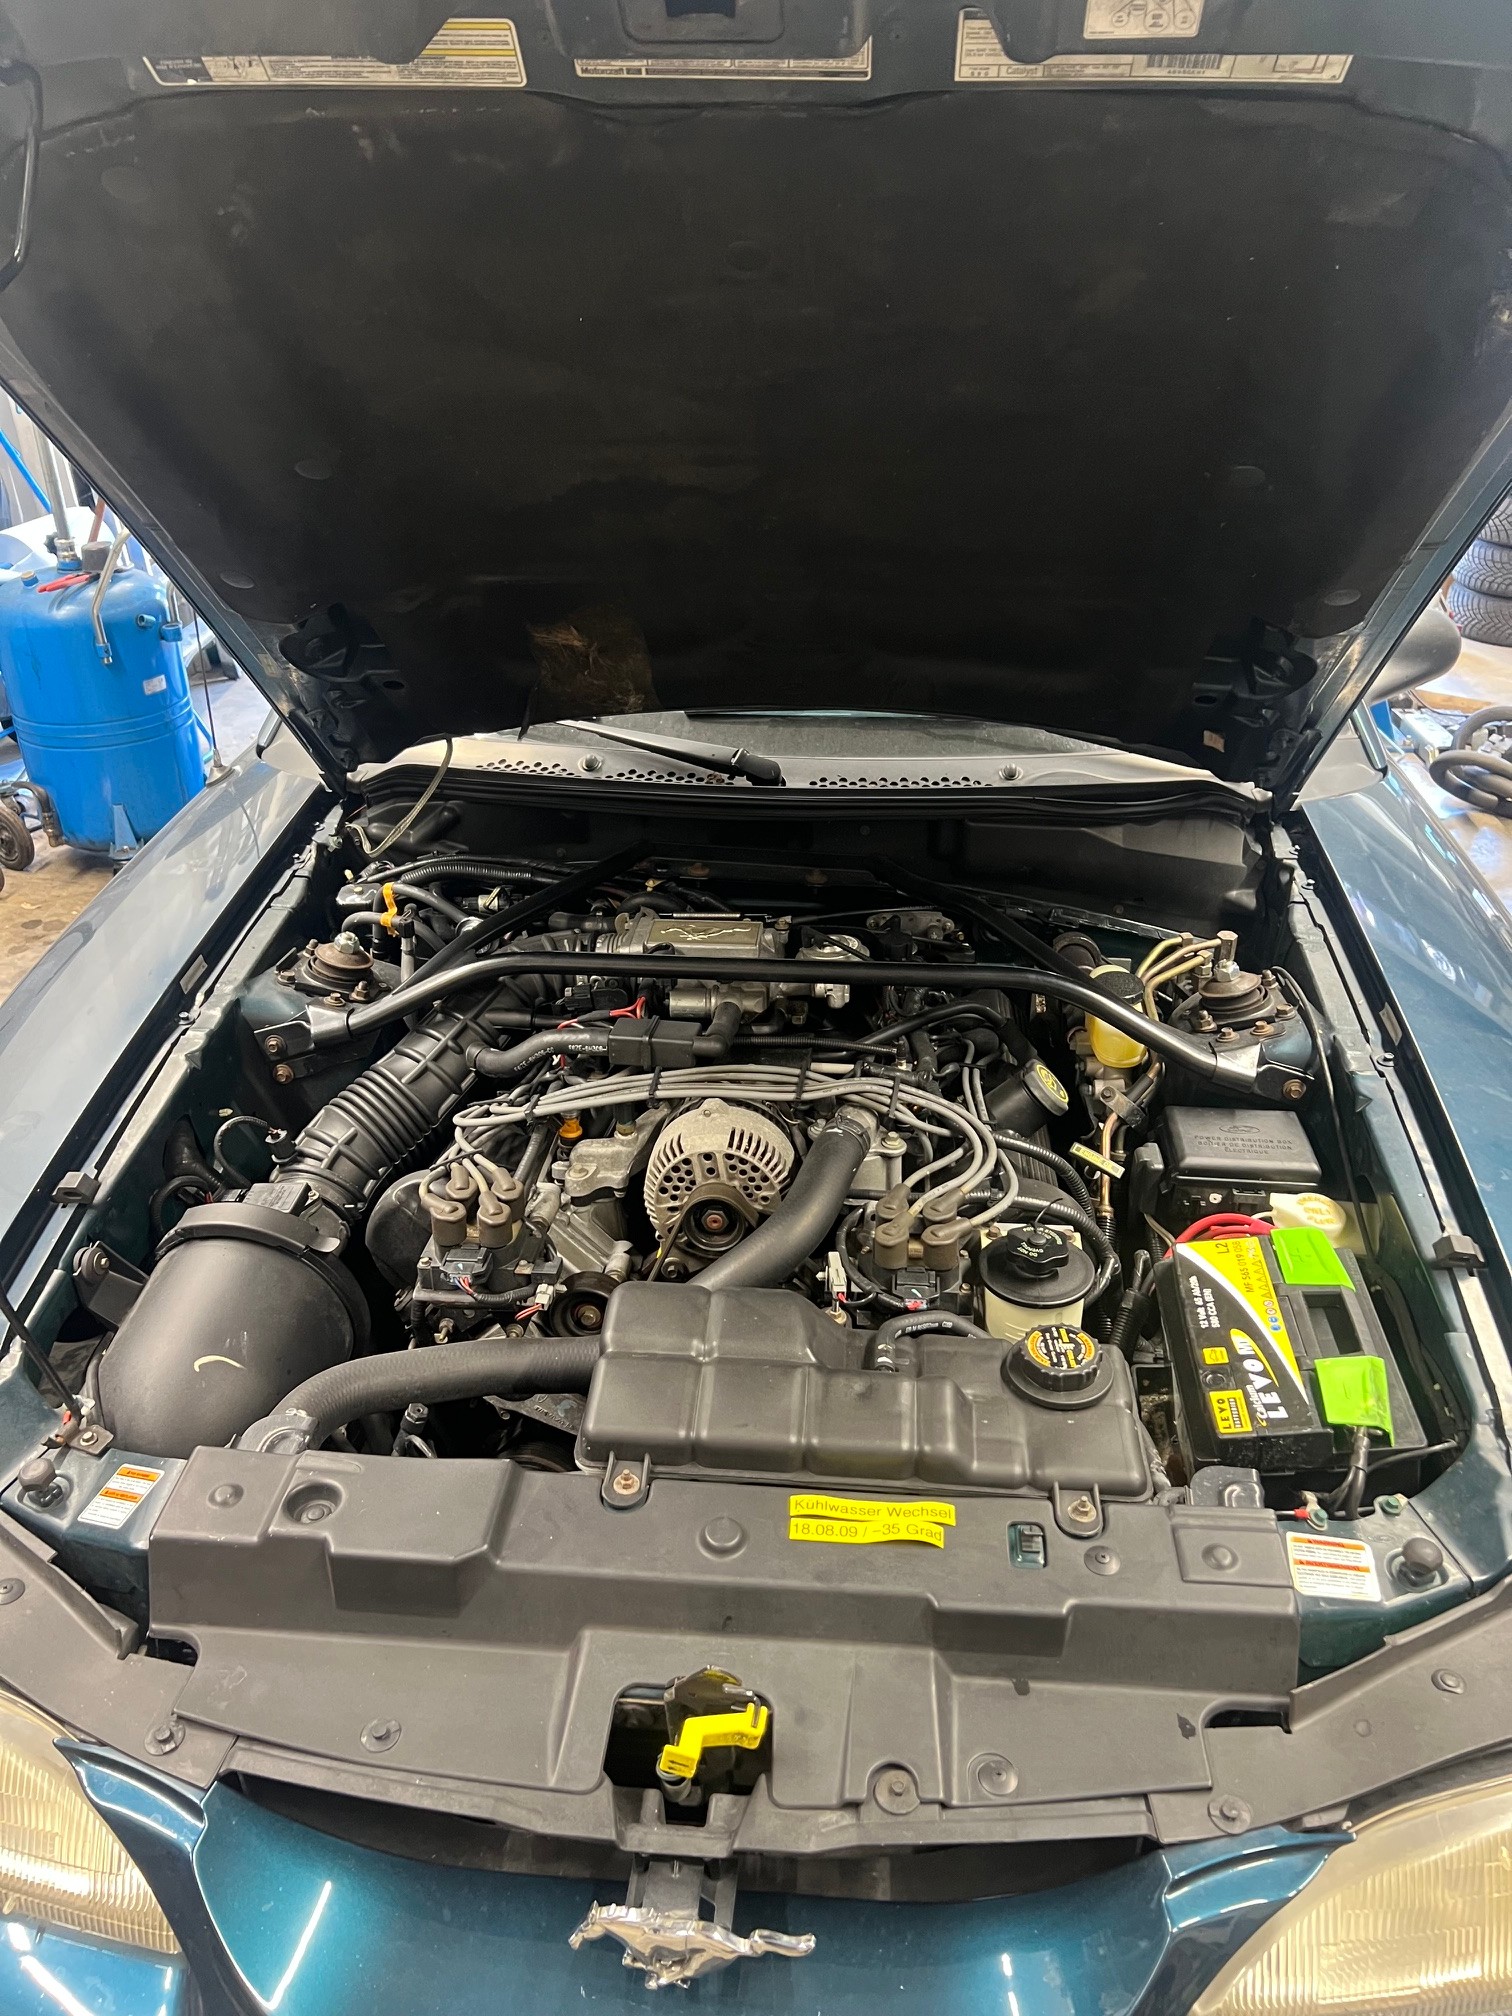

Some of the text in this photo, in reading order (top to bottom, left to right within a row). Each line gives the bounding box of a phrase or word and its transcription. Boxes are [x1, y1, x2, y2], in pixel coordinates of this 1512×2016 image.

[581, 66, 624, 75] Motorcraft
[1006, 66, 1038, 76] Catalyst
[1215, 1242, 1230, 1254] L2
[1236, 1254, 1247, 1266] 019
[1240, 1267, 1251, 1280] 565
[1244, 1282, 1255, 1293] MF
[1193, 1297, 1204, 1306] 65
[1196, 1306, 1207, 1320] Volt
[1206, 1301, 1217, 1316] CCA
[1199, 1319, 1209, 1329] 12
[1242, 1359, 1289, 1418] LEVO
[1245, 1385, 1268, 1420] Calcium
[1216, 1398, 1232, 1430] LEVO
[795, 1498, 952, 1520] Kühlwasser Wechsel
[792, 1523, 858, 1538] 18.08.09
[863, 1527, 868, 1537] /
[906, 1523, 942, 1542] Grad
